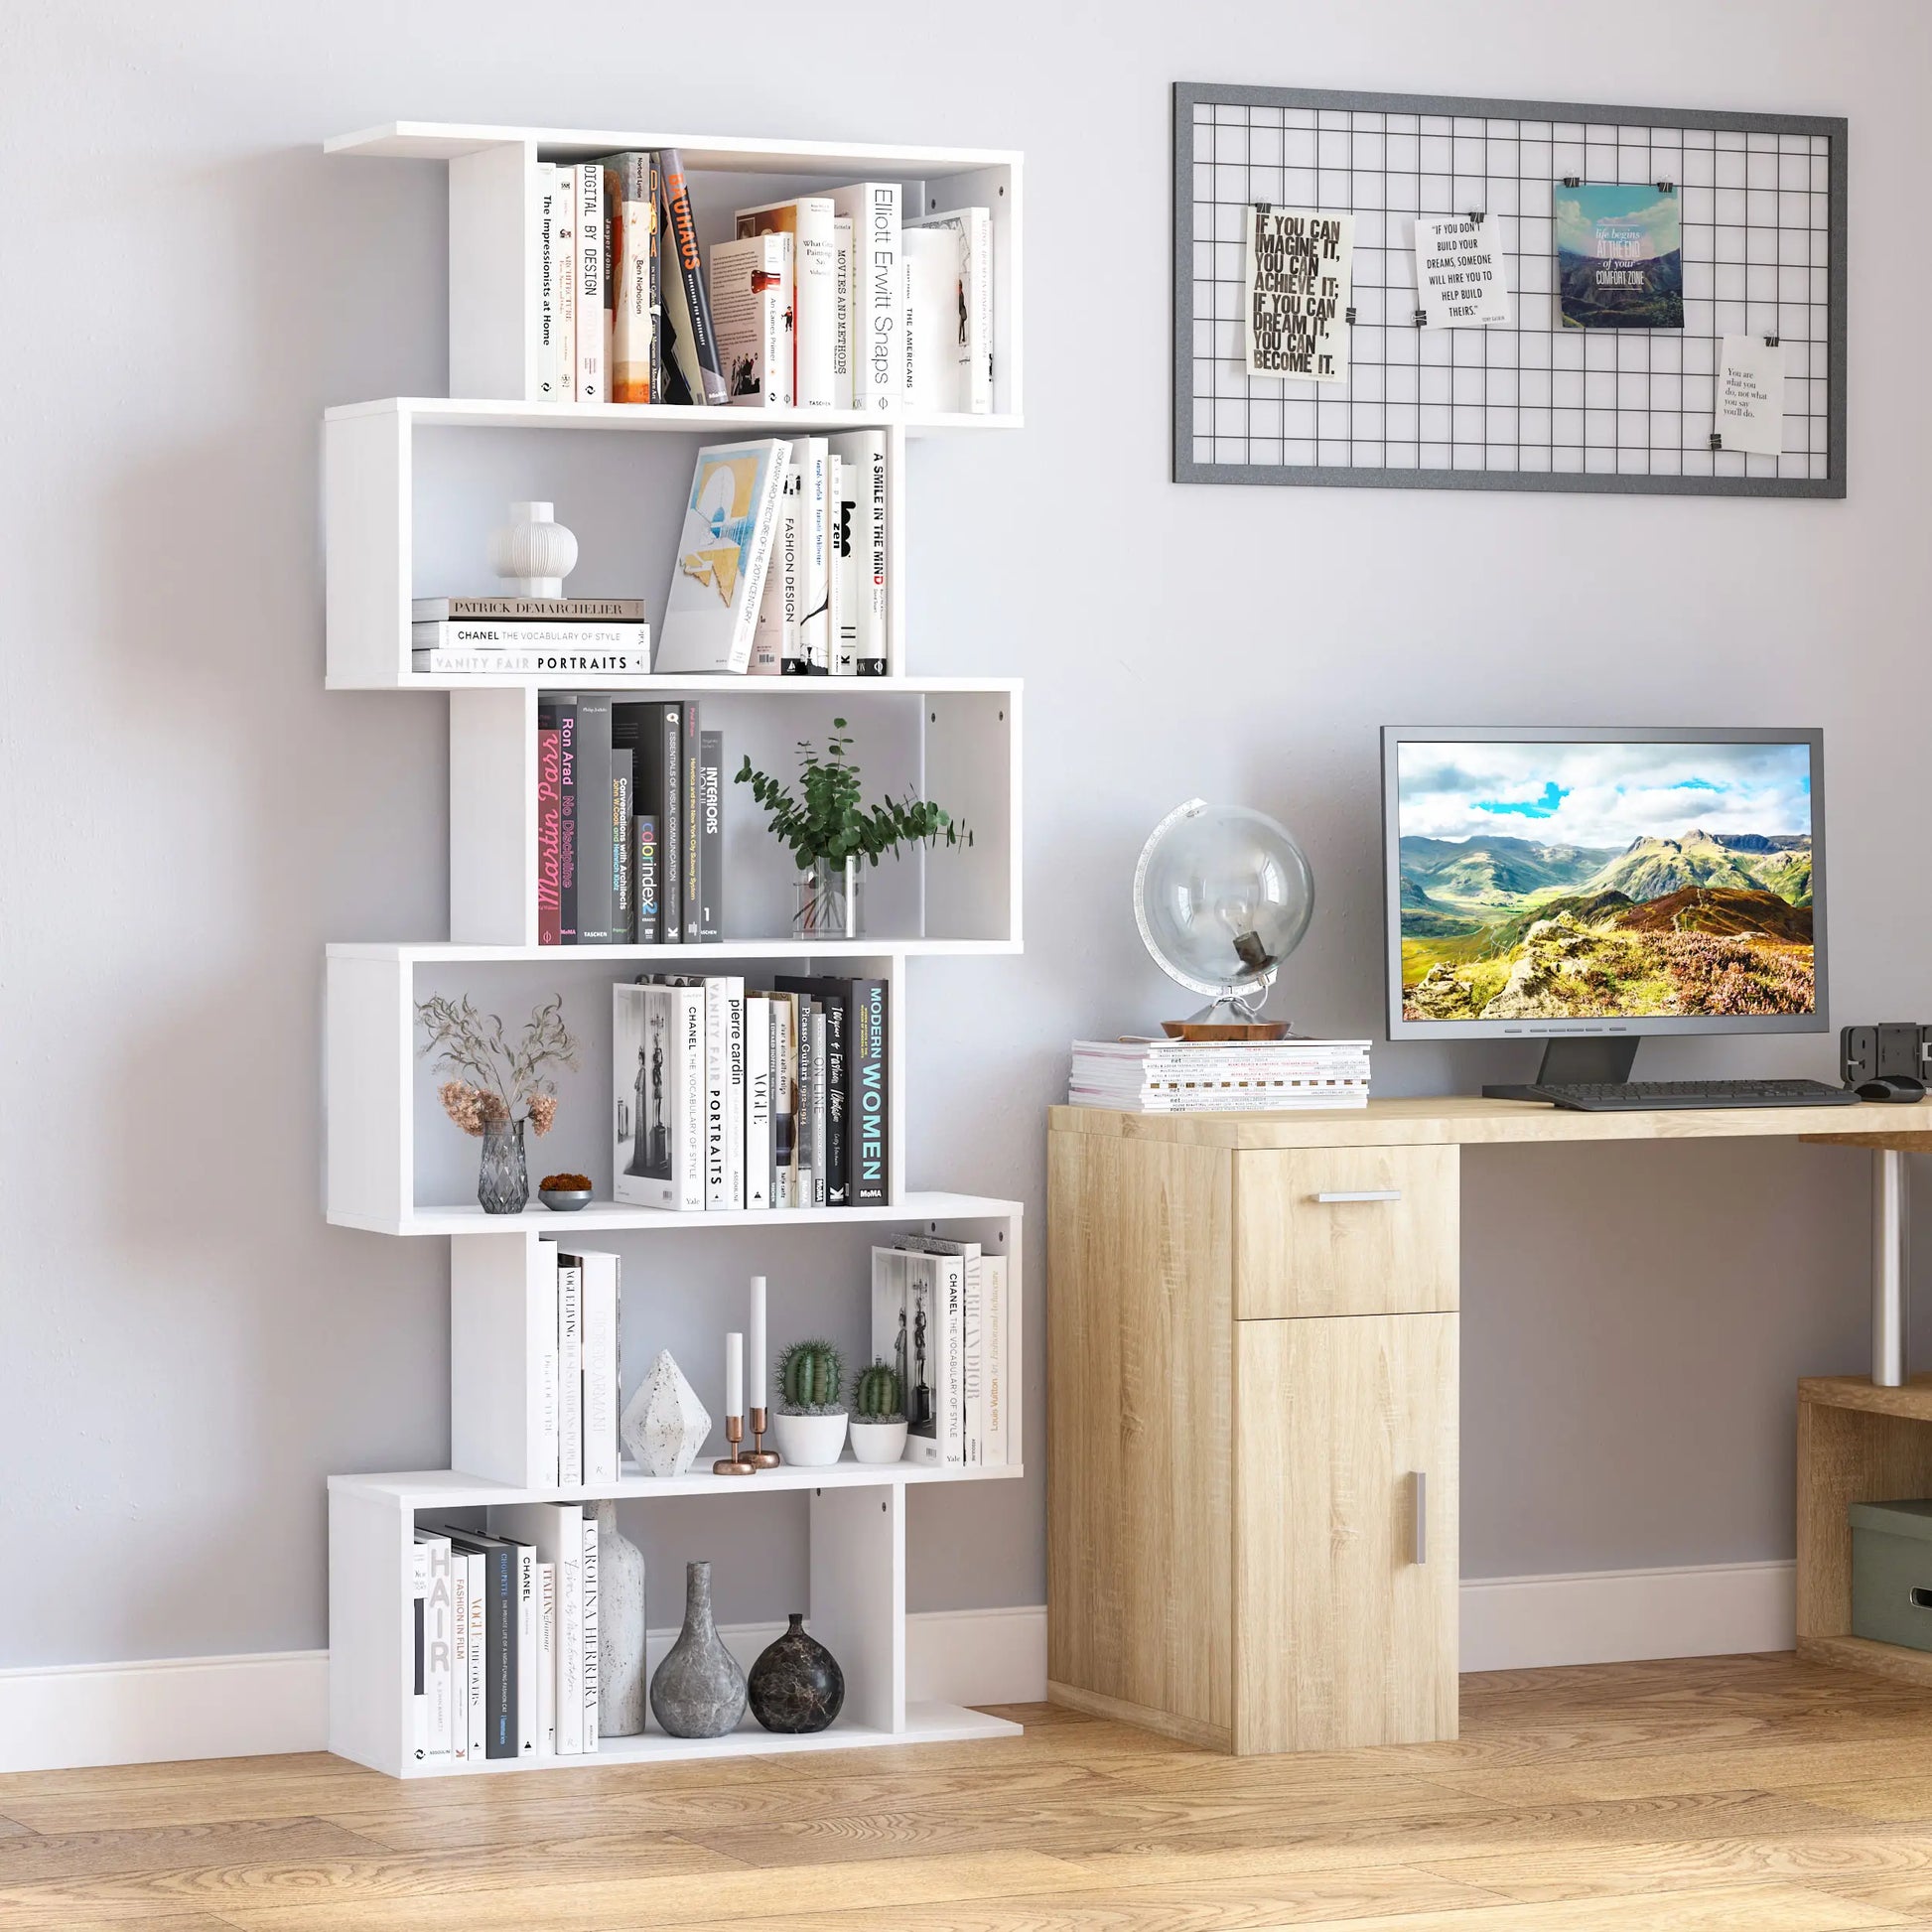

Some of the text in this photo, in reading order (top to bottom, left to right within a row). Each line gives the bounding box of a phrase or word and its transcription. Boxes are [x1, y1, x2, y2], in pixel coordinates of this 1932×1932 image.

[584, 165, 598, 296] DIGITAL BY DESIGN
[604, 217, 613, 250] Jasper
[667, 172, 702, 271] BAUHAUS
[1256, 213, 1340, 240] IF YOU CAN
[1444, 223, 1457, 233] YOU
[1595, 228, 1640, 242] life begins
[1255, 233, 1340, 262] IMAGINE IT,
[1437, 239, 1478, 251] BUILD YOUR
[1597, 240, 1639, 258] AT THE END
[541, 195, 552, 346] The Impressionists at Home
[1255, 253, 1318, 277] YOU CAN
[1427, 254, 1492, 269] DREAMS, SOMEONE
[1602, 258, 1635, 270] of your
[871, 188, 894, 385] Elliott Erwitt Snaps
[1254, 271, 1339, 300] ACHIEVE IT;
[1429, 270, 1493, 285] WILL HIRE YOU TO
[1595, 270, 1644, 285] COMFORT ZONE
[635, 276, 644, 315] Nicholson
[1253, 292, 1335, 319] IF YOU CAN
[1442, 288, 1482, 301] HELP BUILD
[837, 249, 847, 374] MOVIES AND METHODS
[1253, 312, 1329, 340] DREAM IT,
[1254, 330, 1315, 354] YOU CAN
[1254, 349, 1335, 374] BECOME IT.
[1727, 367, 1741, 377] You
[1725, 378, 1741, 387] what
[1725, 388, 1736, 397] do,
[1751, 391, 1767, 400] what
[1725, 398, 1737, 407] you
[1742, 409, 1755, 418] do.
[874, 453, 884, 462] A
[873, 466, 884, 504] SMILE
[873, 507, 884, 520] IN
[873, 524, 884, 548] THE
[785, 517, 795, 623] FASHION DESIGN
[873, 551, 884, 585] MIND
[455, 602, 623, 615] PATRICK DEMARCHELIER
[458, 630, 621, 641] CHANEL THE VOCABULARY OF STYLE
[436, 657, 627, 670] VANITY FAIR PORTRAITS
[668, 731, 677, 776] ESSENTIALS
[668, 776, 677, 787] OF
[560, 718, 575, 889] Ron Arad No Discipline
[668, 788, 677, 816] VISUAL
[706, 766, 719, 834] INTERIORS
[538, 733, 559, 907] Martin Parr
[668, 816, 677, 882] COMMUNICATION
[703, 906, 710, 922] 1
[688, 1006, 697, 1050] CHANEL
[728, 999, 744, 1085] pierre cardin
[801, 1007, 812, 1081] Picasso Guitars
[688, 1052, 697, 1071] THE
[813, 1056, 825, 1077] ON
[709, 983, 722, 1185] VANITY FAIR PORTRAITS
[862, 987, 882, 1180] MODERN WOMEN
[688, 1072, 697, 1135] VOCABULARY
[813, 1083, 825, 1114] LINE
[688, 1136, 697, 1150] OF
[815, 1179, 824, 1202] MoMA
[860, 1188, 883, 1199] MoMA
[949, 1273, 958, 1439] CHANEL THE VOCABULARY OF STYLE
[522, 1556, 531, 1602] CHANEL
[543, 1570, 553, 1614] ITALIAN
[430, 1547, 451, 1673] HAIR
[456, 1579, 465, 1660] FASHION IN FILM
[584, 1528, 598, 1710] CAROLINA HERRERA
